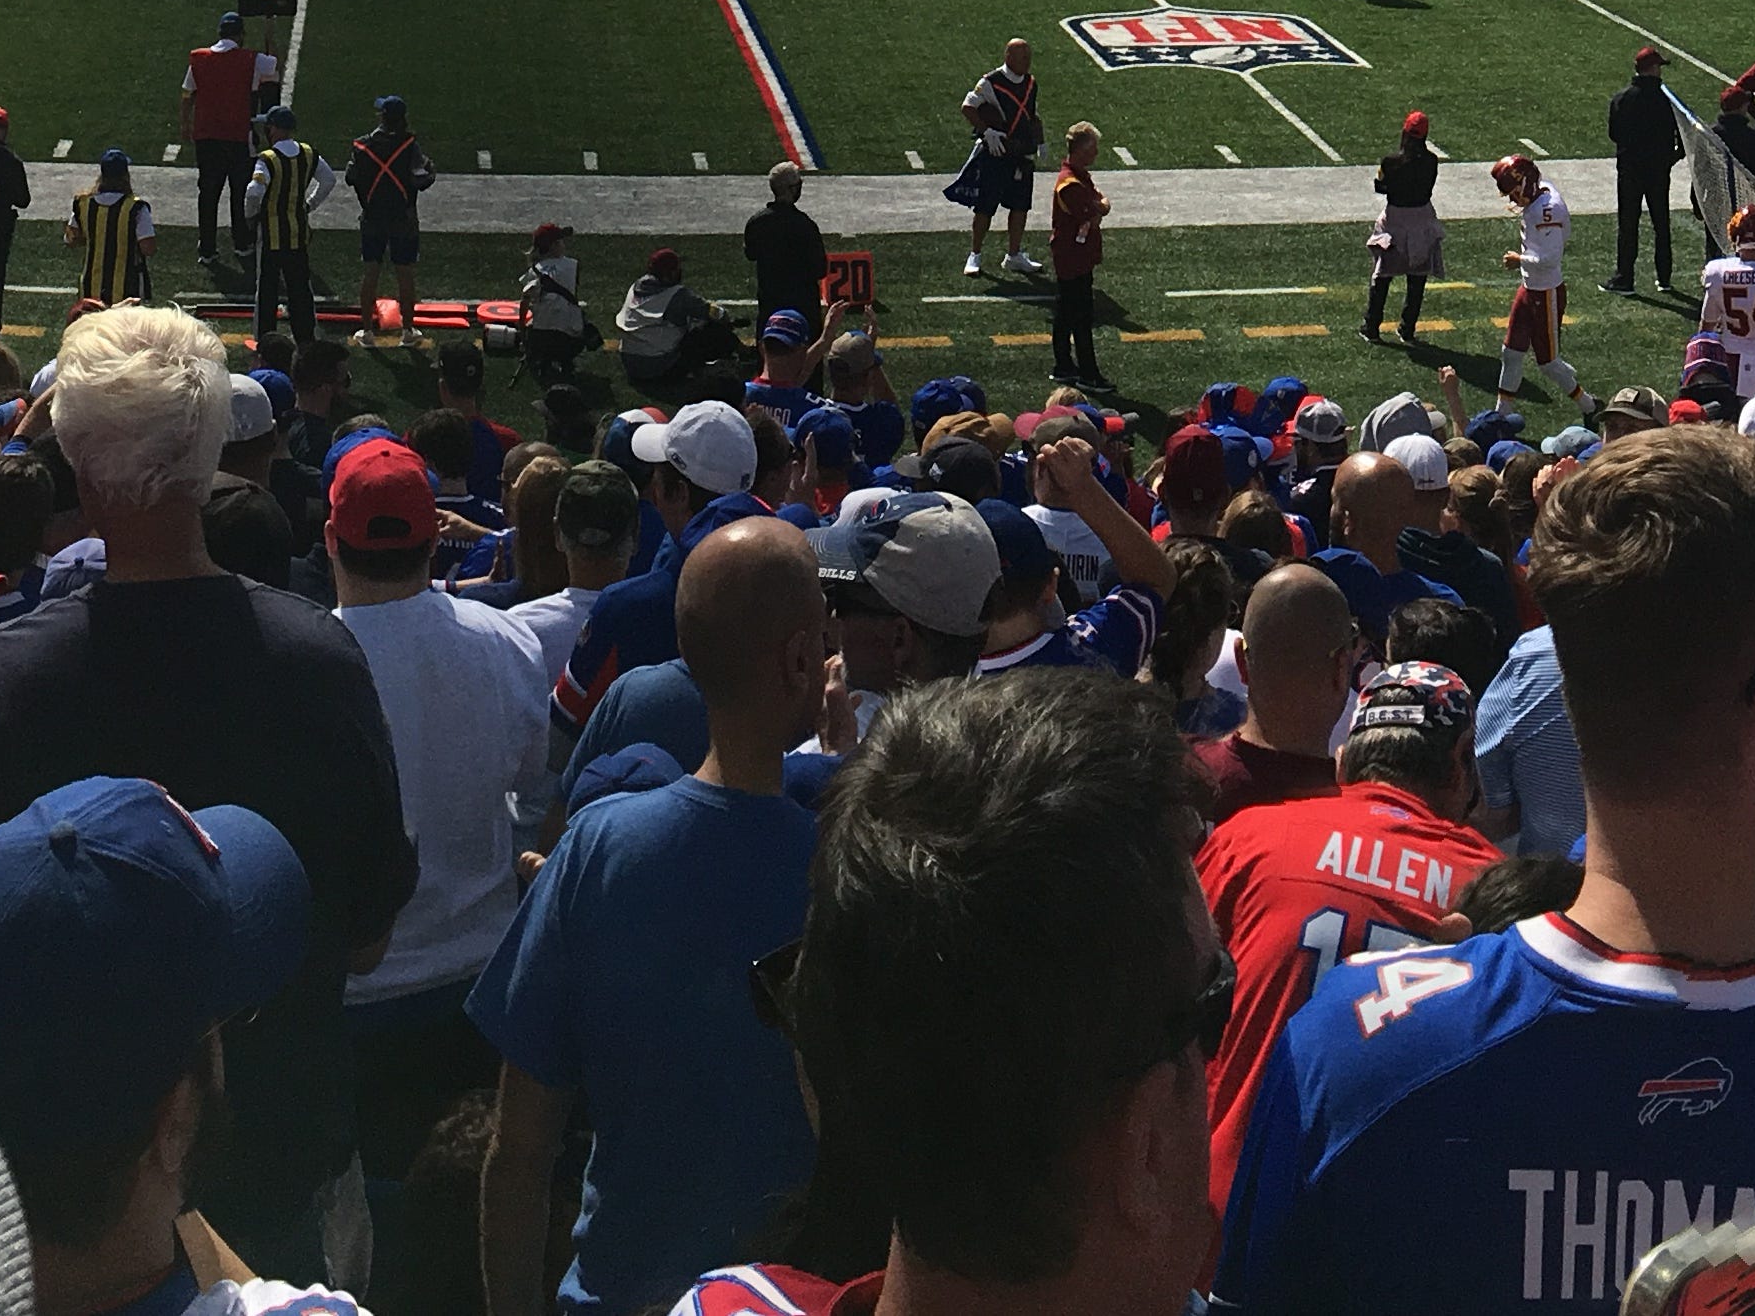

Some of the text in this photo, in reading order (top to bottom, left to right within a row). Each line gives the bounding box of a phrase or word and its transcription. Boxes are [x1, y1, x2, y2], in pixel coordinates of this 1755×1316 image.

[1542, 209, 1552, 223] 5
[829, 260, 870, 300] 20
[817, 567, 857, 581] BILLS
[1316, 830, 1454, 910] ALLEN
